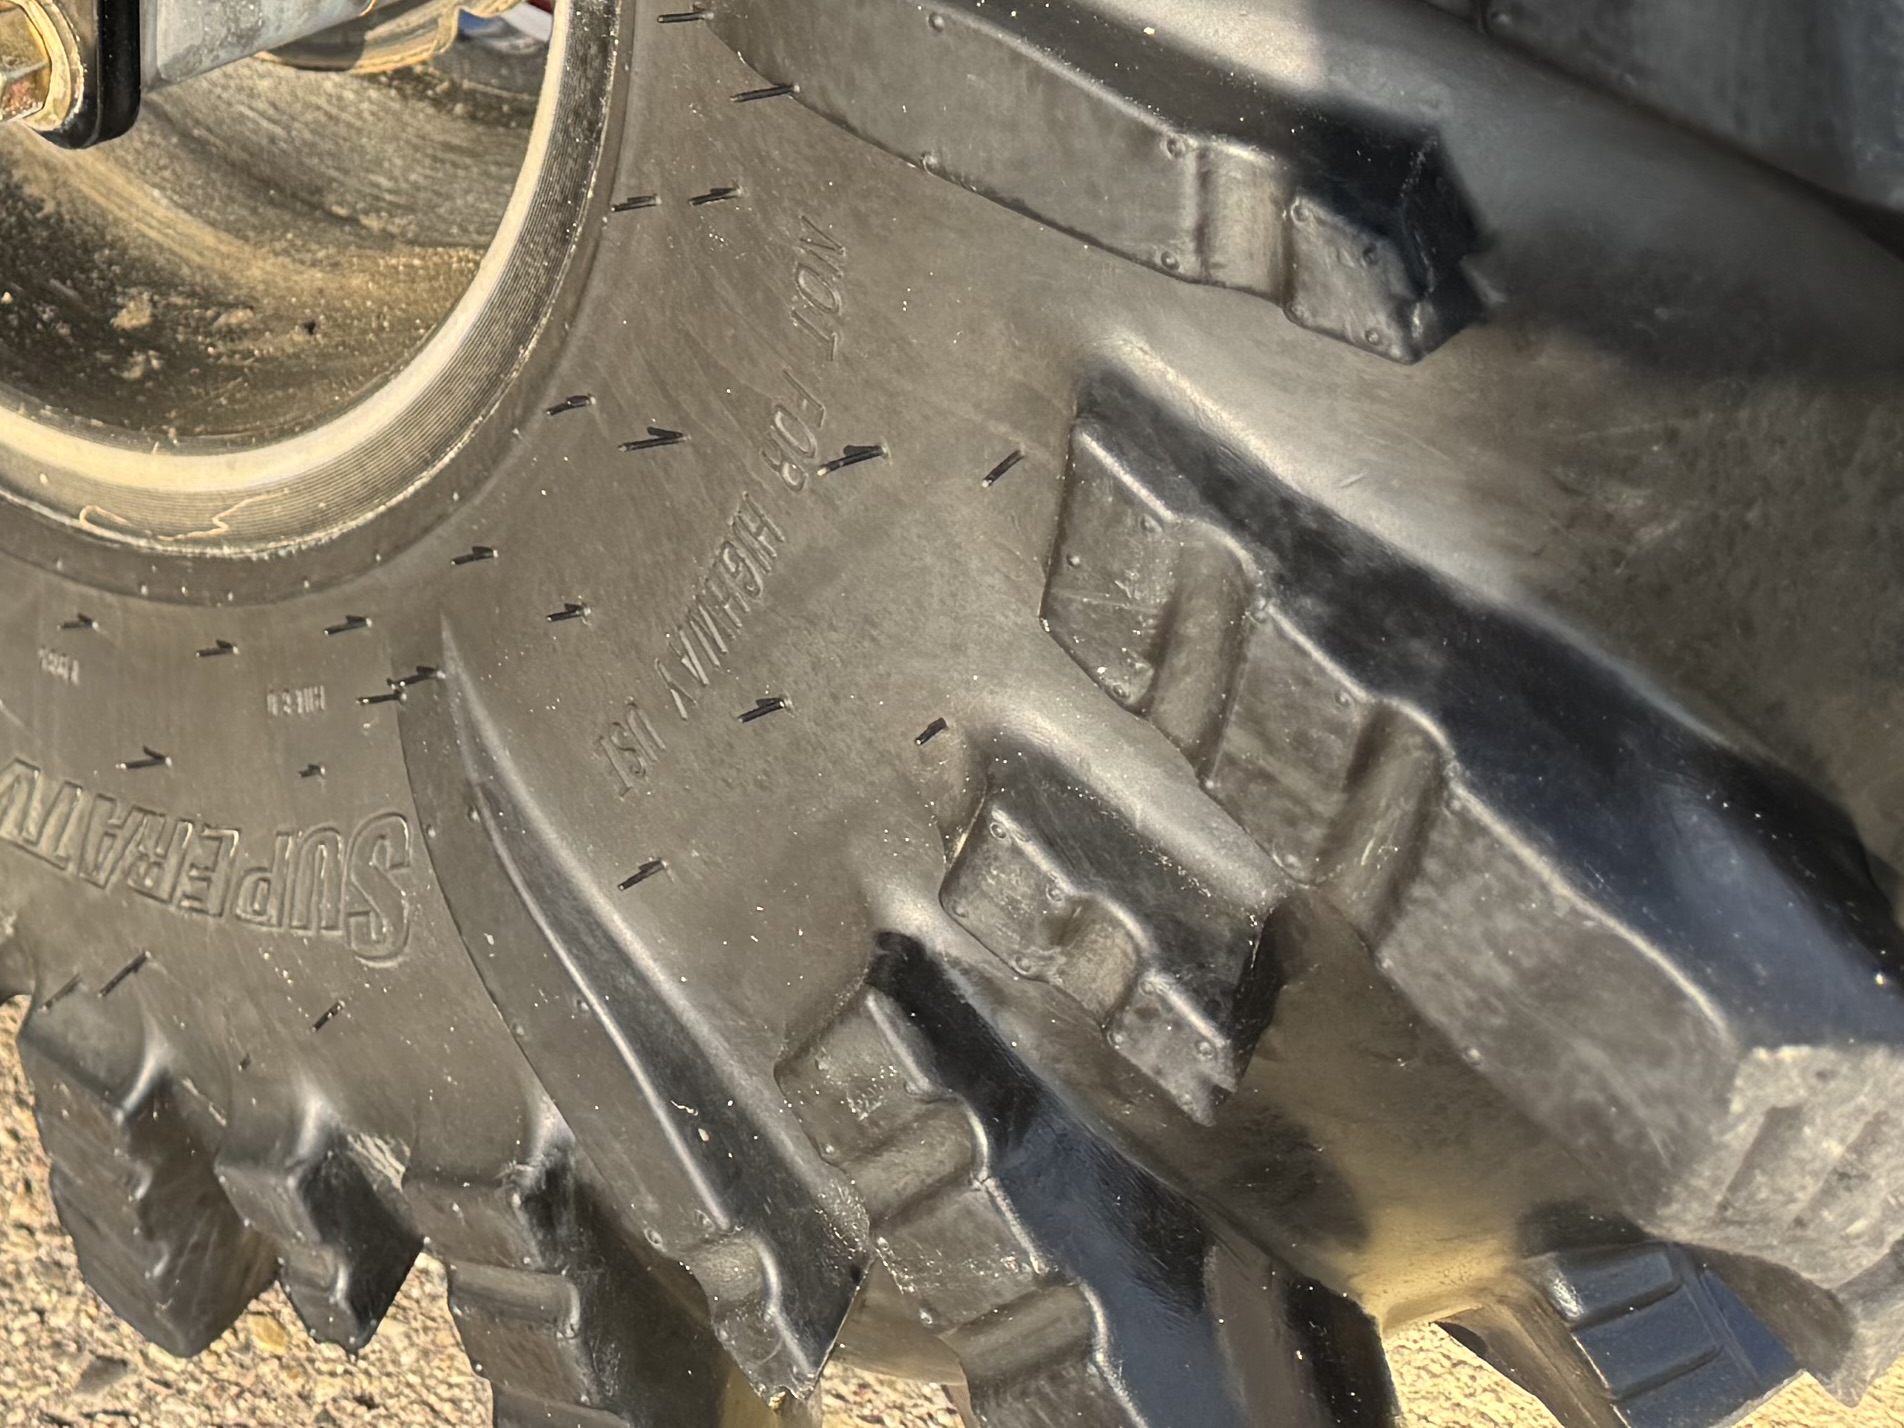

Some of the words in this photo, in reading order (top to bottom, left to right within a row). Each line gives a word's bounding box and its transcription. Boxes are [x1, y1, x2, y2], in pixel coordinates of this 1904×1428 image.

[791, 215, 849, 361] NOT
[762, 371, 828, 492] FOR
[653, 490, 786, 721] HIGHWAY
